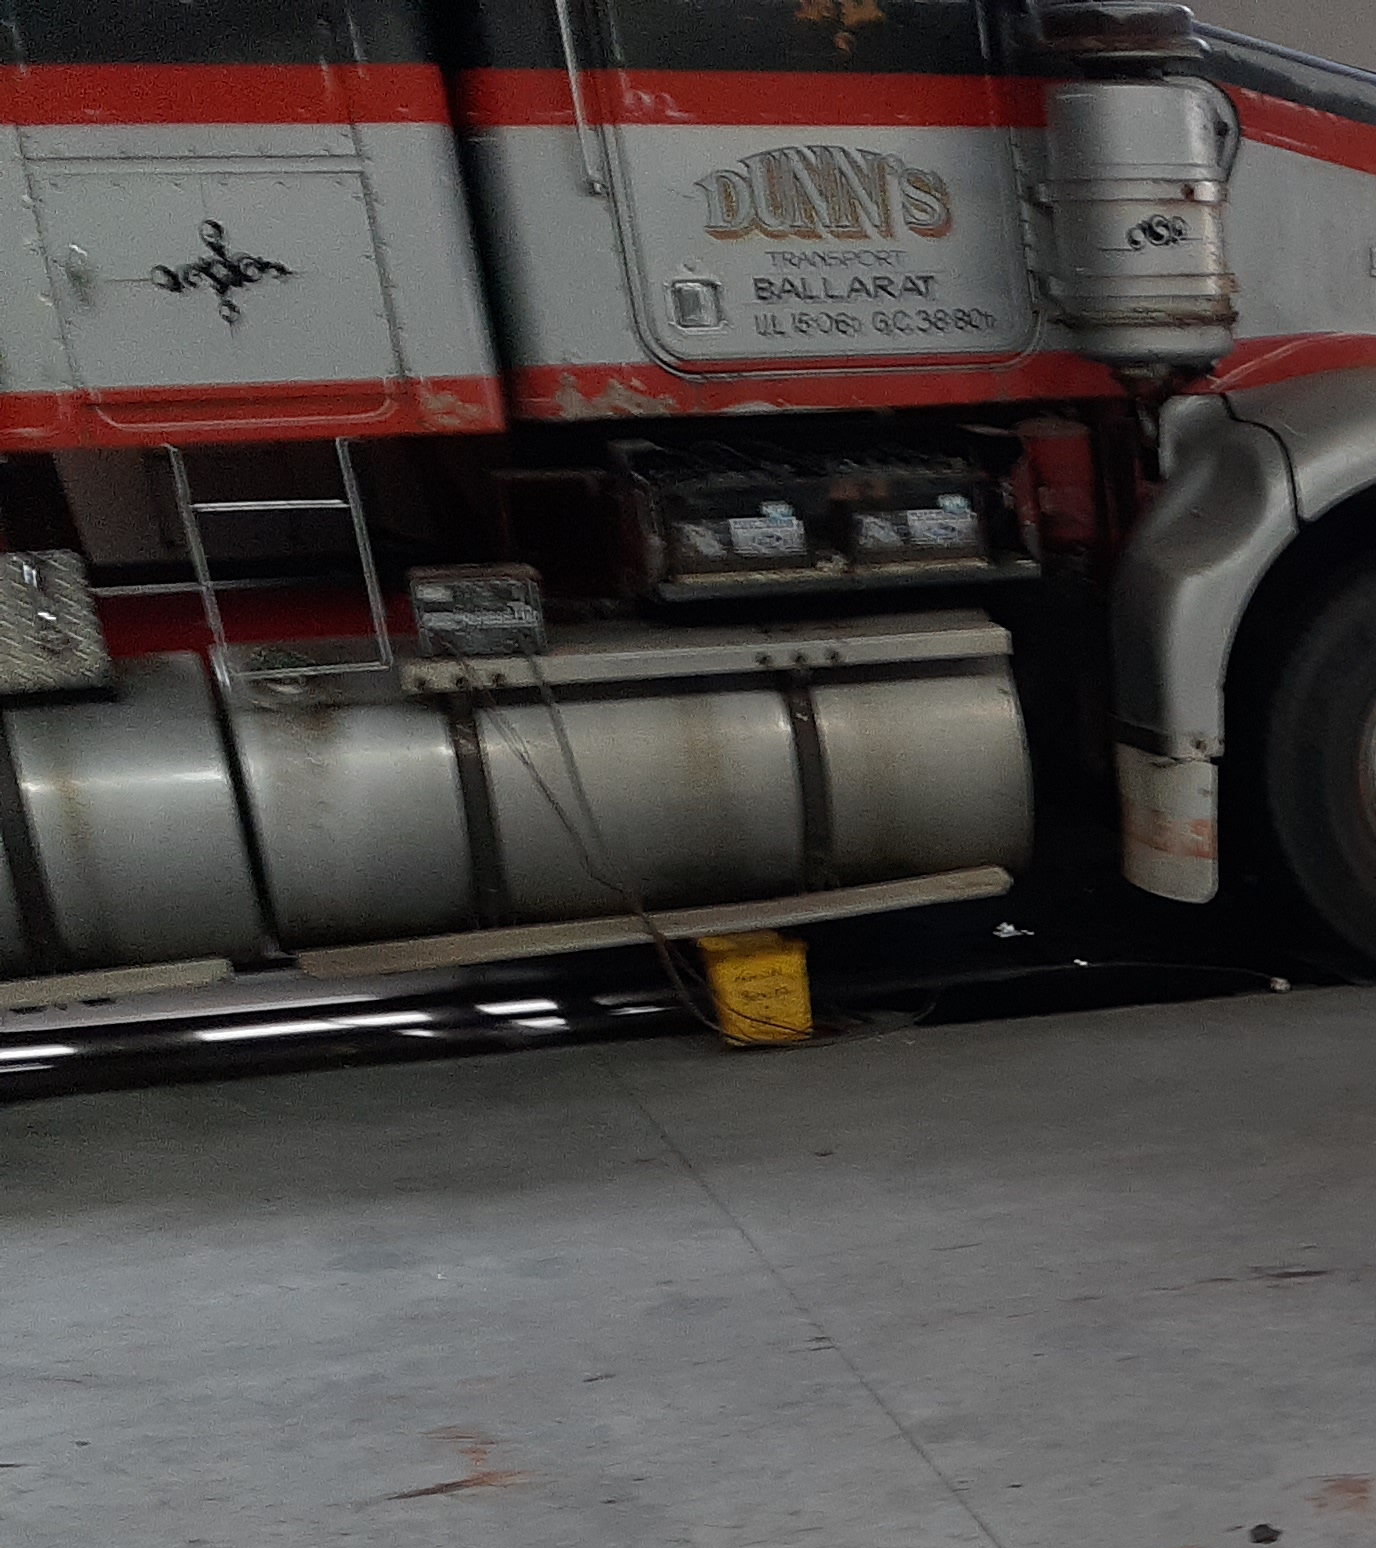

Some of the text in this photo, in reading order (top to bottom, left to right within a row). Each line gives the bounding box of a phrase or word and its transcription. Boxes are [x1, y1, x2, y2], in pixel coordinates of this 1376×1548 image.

[693, 144, 951, 240] DUNN'S
[765, 249, 908, 269] TRANSPORT
[752, 275, 936, 301] BALLARAT
